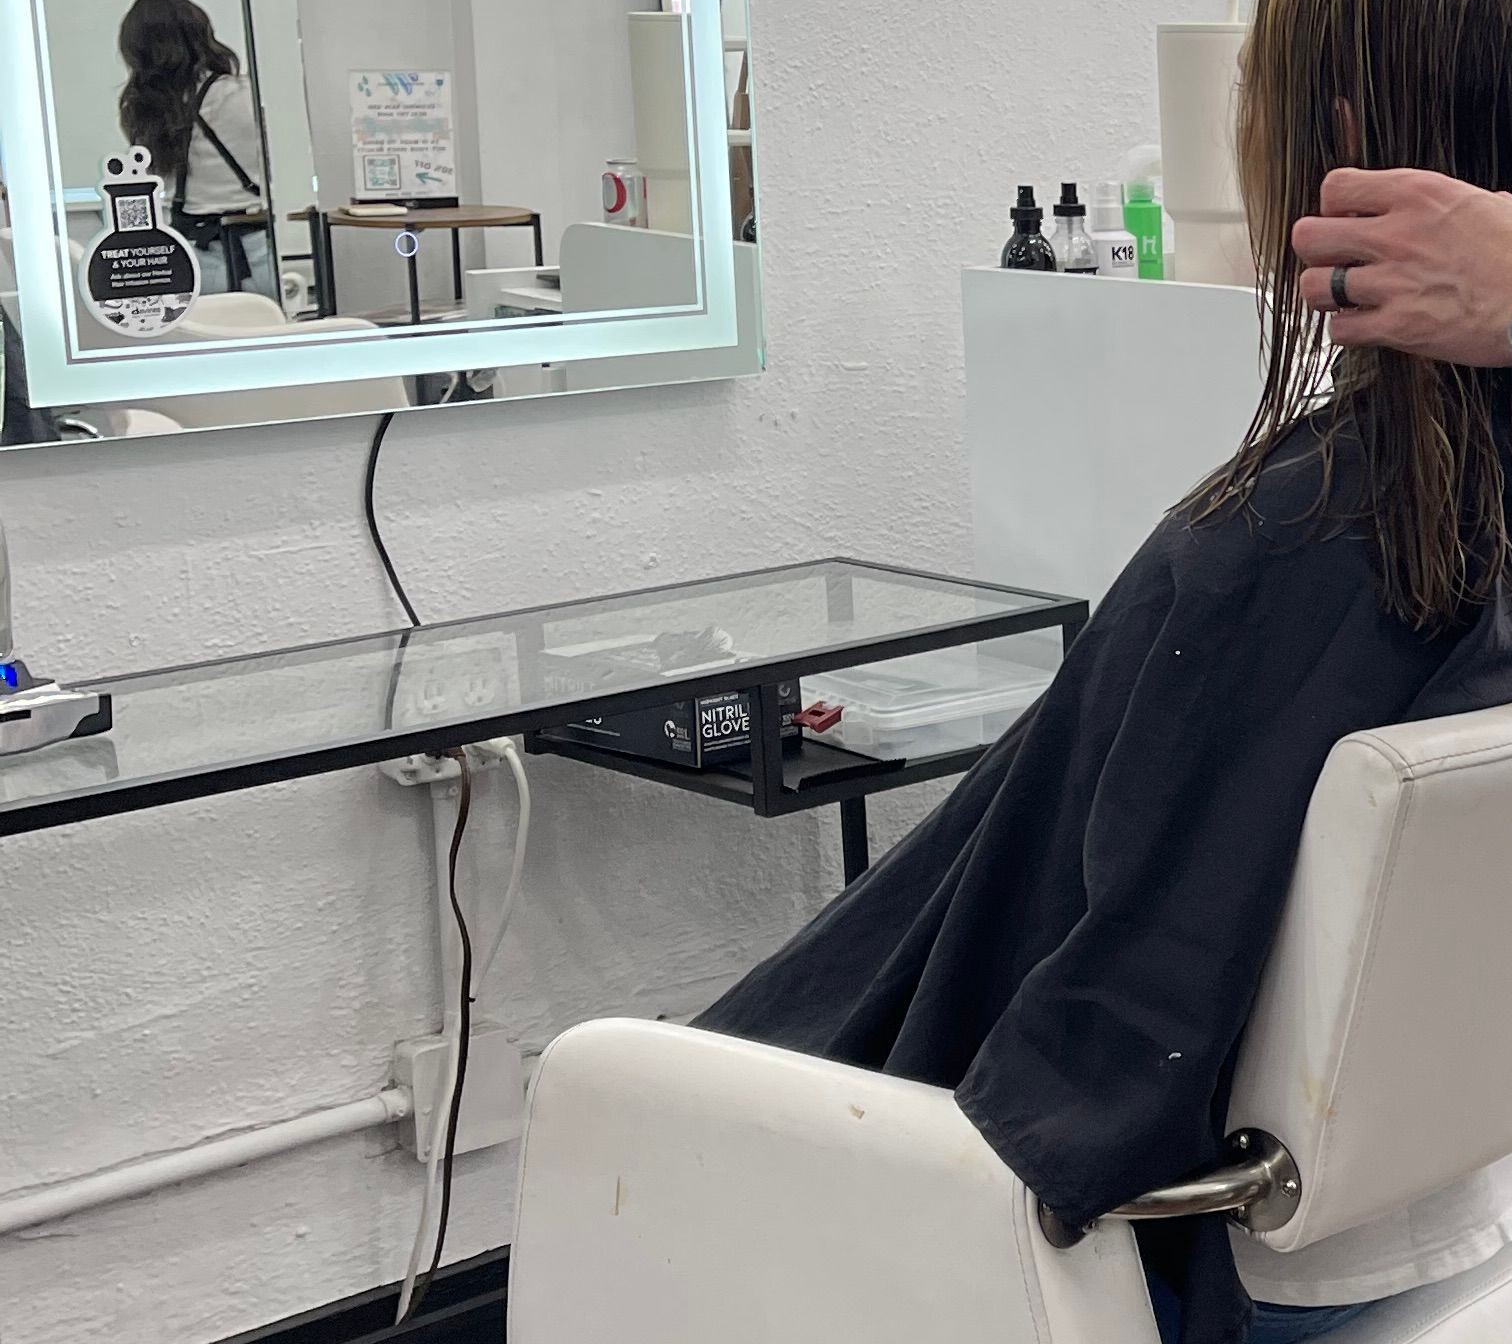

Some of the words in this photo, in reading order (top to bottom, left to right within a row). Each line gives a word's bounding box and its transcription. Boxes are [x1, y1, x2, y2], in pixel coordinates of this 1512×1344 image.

[101, 249, 129, 260] TREAT
[129, 244, 175, 257] YOURSELF
[1111, 245, 1134, 261] K18
[112, 260, 120, 269] &
[121, 258, 146, 268] YOUR
[147, 256, 168, 266] HAIR
[701, 703, 750, 724] NITRIL
